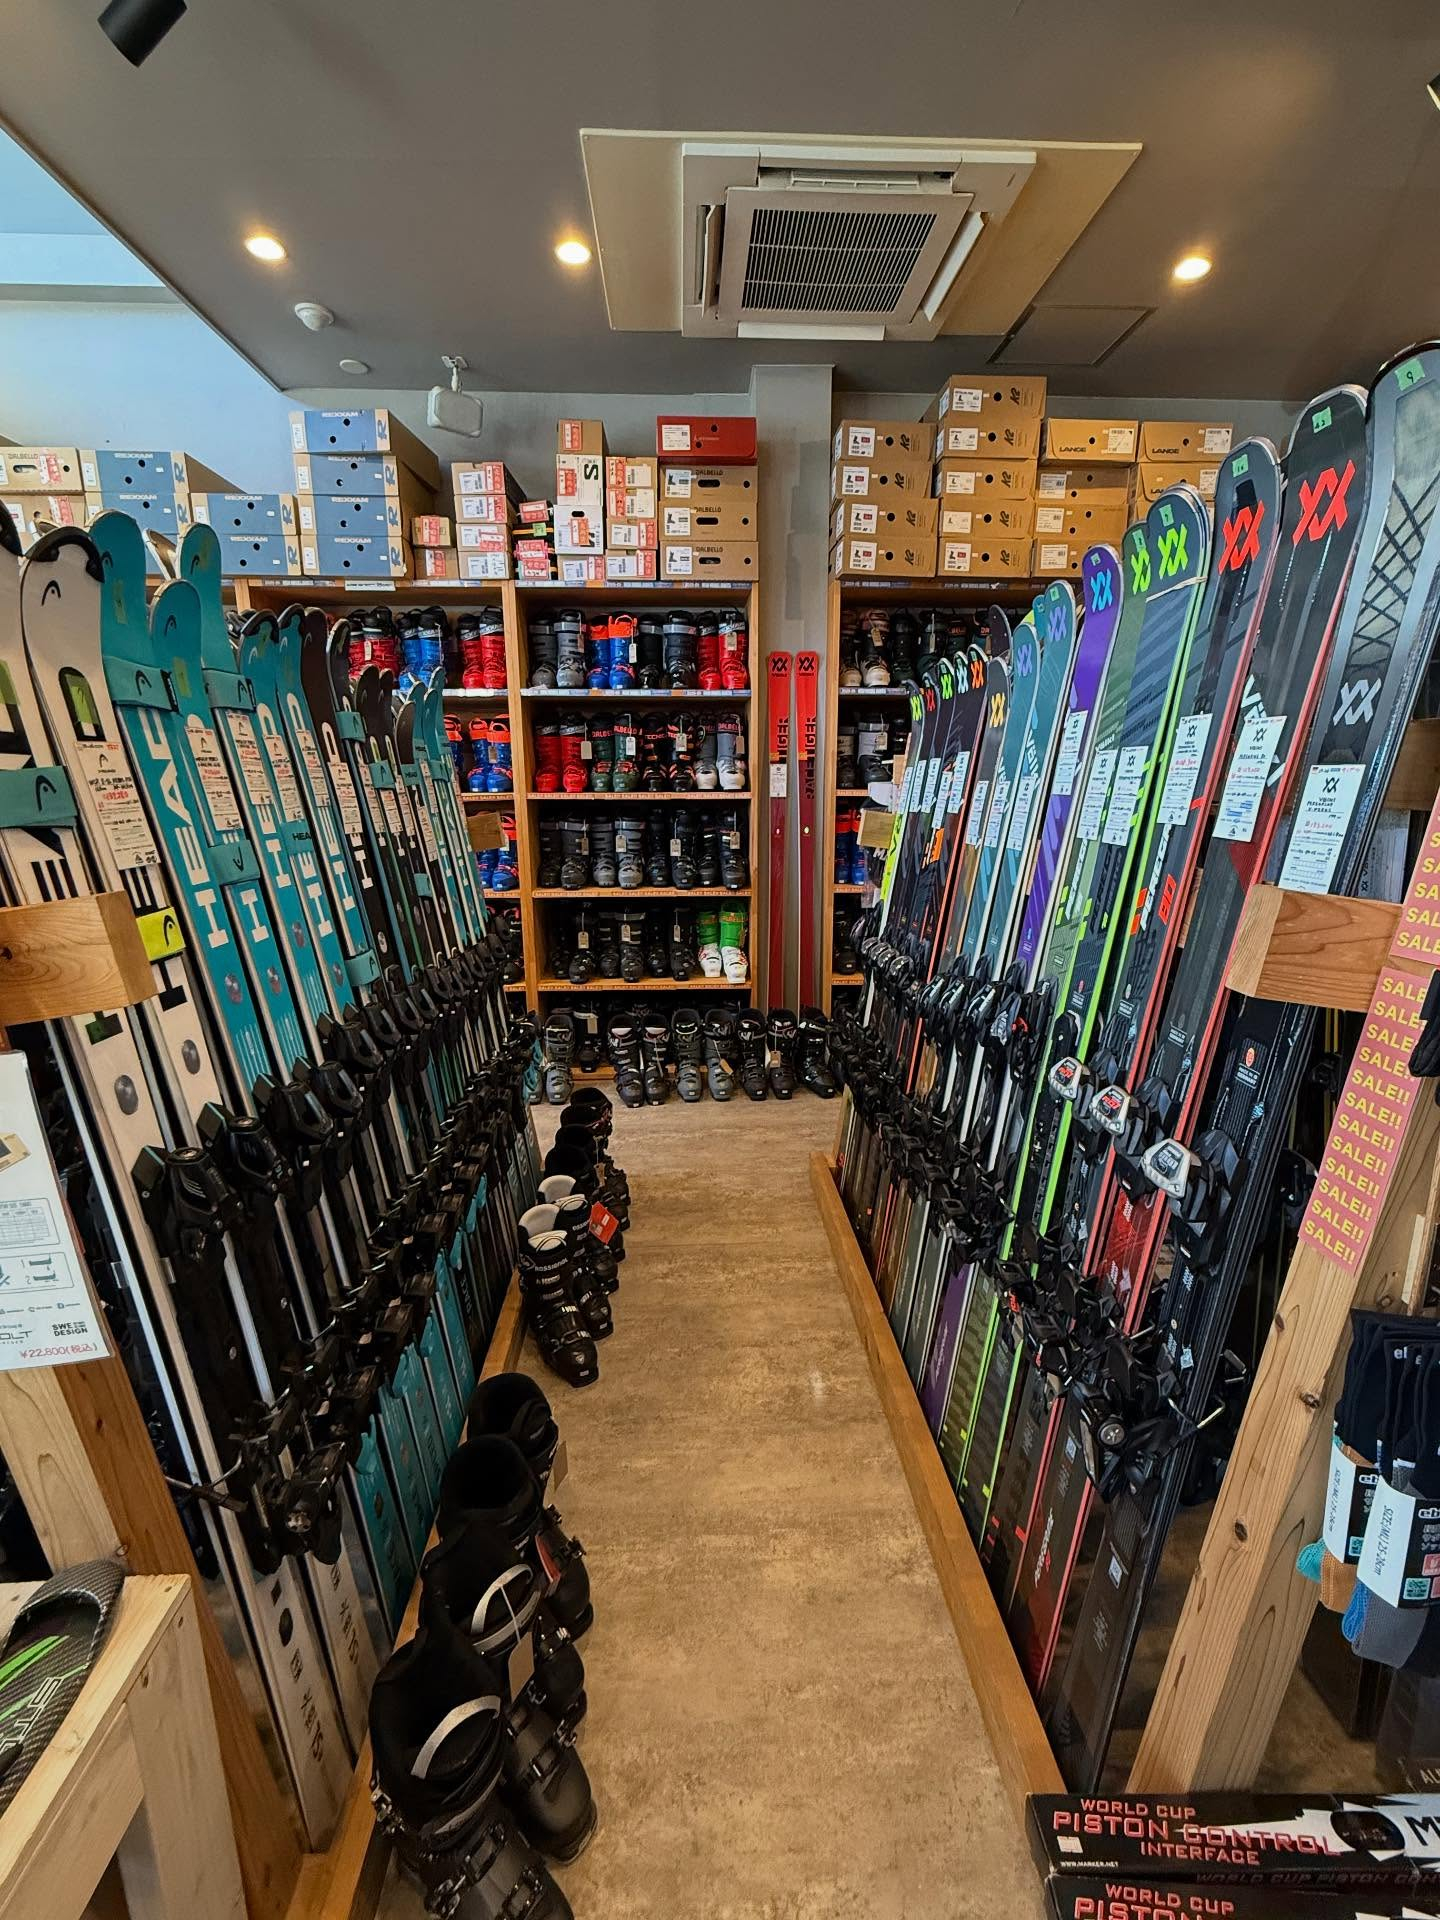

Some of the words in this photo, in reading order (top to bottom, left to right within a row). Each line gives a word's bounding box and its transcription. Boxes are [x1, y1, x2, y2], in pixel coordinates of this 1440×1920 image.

[1397, 932, 1440, 954] SALE
[1382, 977, 1427, 1002] SALE
[1352, 1068, 1410, 1106] SALE!!
[1344, 1092, 1402, 1130] SALE!!
[1338, 1114, 1395, 1152] SALE!!
[1331, 1136, 1388, 1176] SALE!!
[1325, 1157, 1380, 1199] SALE!!
[1318, 1178, 1373, 1222] SALE!!
[1312, 1200, 1364, 1243] SALE!!
[1304, 1220, 1356, 1264] SALE!!
[54, 1328, 88, 1337] DESIGN
[1080, 1798, 1149, 1816] WORLD
[1156, 1804, 1196, 1820] CUP
[1053, 1810, 1169, 1840] PISTON
[1183, 1822, 1342, 1857] CONTROL
[1140, 1841, 1260, 1866] INTERFACE
[1270, 1873, 1312, 1884] CUP
[1316, 1873, 1389, 1884] PISTON
[1105, 1883, 1181, 1908] WORLD
[1190, 1896, 1234, 1916] CUP
